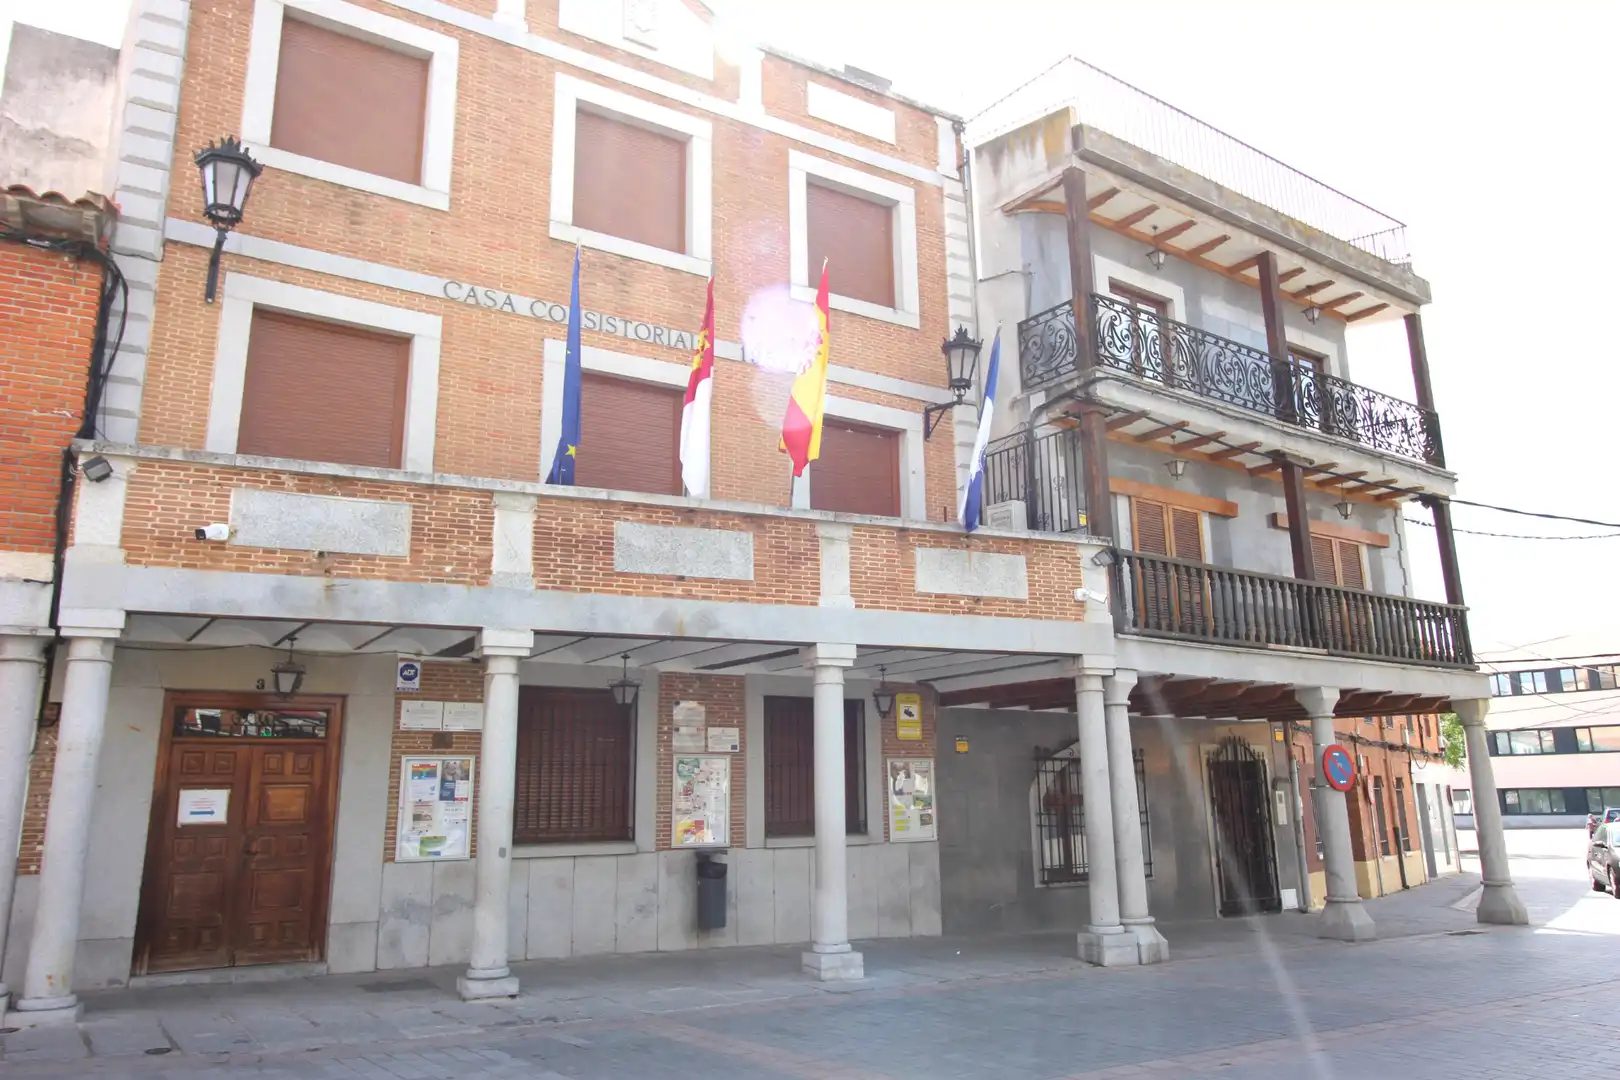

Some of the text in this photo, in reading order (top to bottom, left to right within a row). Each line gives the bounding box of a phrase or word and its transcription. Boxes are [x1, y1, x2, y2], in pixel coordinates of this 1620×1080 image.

[443, 280, 700, 350] CASA COSISTORIAL
[256, 678, 265, 690] 3
